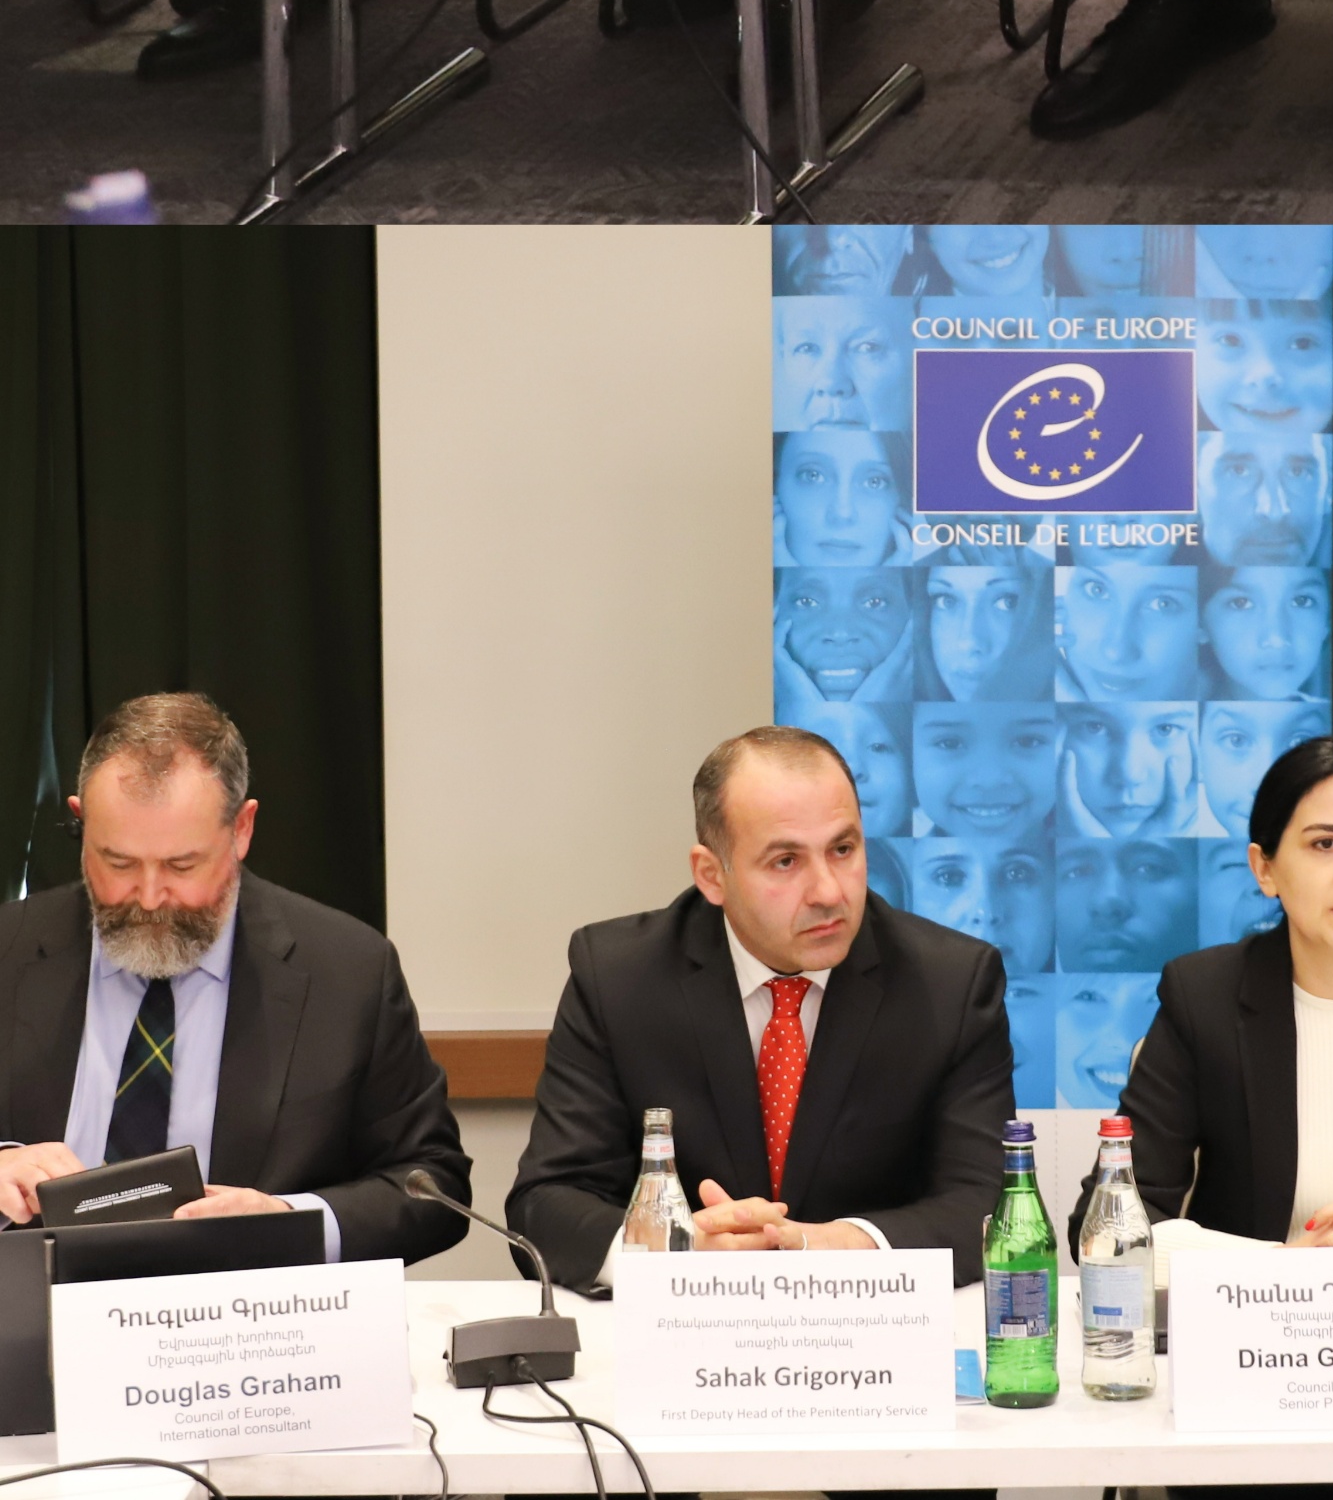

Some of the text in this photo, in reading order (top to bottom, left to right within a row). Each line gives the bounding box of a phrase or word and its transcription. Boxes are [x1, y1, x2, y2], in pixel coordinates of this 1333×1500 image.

[911, 317, 1197, 340] COUNCIL OF EUROPE
[911, 524, 1198, 547] CONSEIL DE L'EUROPE
[671, 1273, 915, 1300] Սահակ Գրիգորյան
[1216, 1284, 1314, 1308] Դիանա
[108, 1290, 351, 1329] Դուգլաս Գրահամ
[657, 1313, 930, 1330] Քրեակատարողական ծառայության պետի
[735, 1336, 853, 1350] առաջին տեղակալ
[148, 1343, 316, 1369] Միջազգային փորձագետ
[1238, 1348, 1308, 1369] Diana
[695, 1366, 892, 1390] Sahak Grigoryan
[1287, 1381, 1333, 1394] Council
[125, 1373, 341, 1407] Douglas Graham
[174, 1404, 296, 1425] Council of Europe,
[661, 1405, 928, 1422] First Deputy Head of the Penitentiary Service
[1279, 1398, 1320, 1410] Senior
[160, 1419, 312, 1442] International consultant
